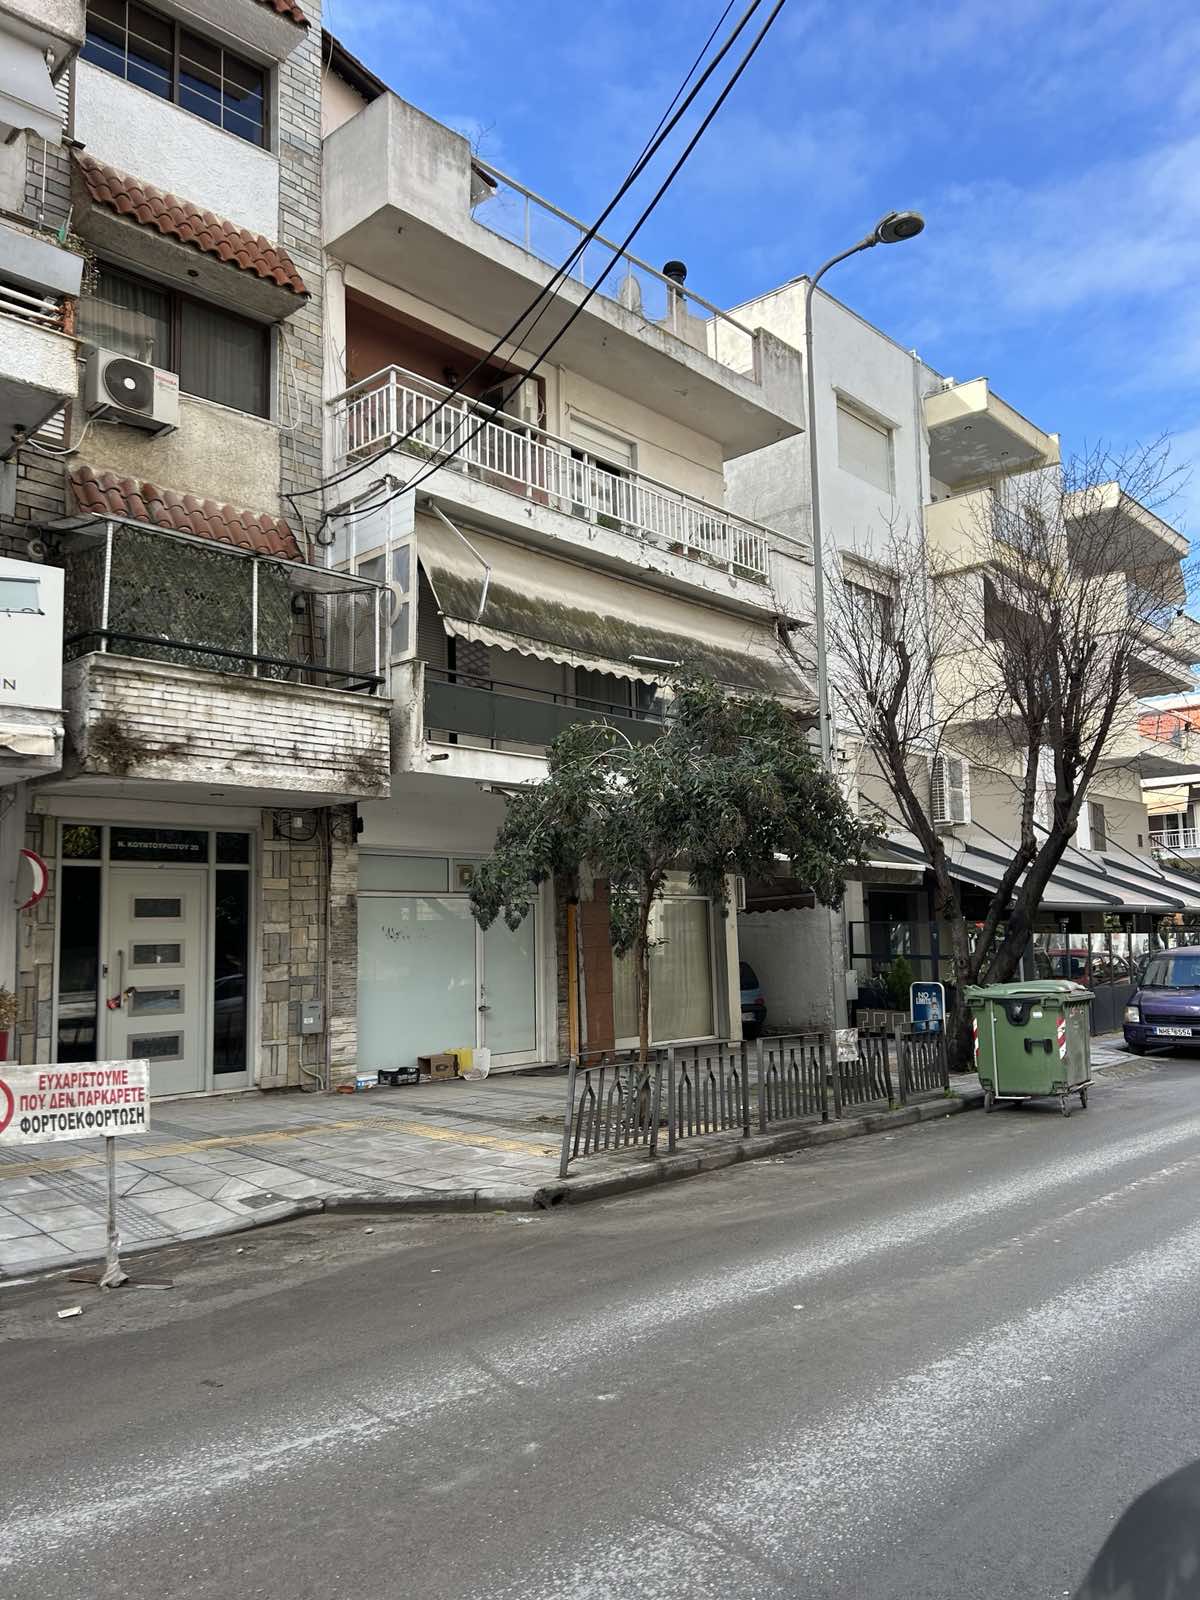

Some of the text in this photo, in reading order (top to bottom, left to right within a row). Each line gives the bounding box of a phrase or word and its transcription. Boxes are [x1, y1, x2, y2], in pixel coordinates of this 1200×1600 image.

[38, 1070, 129, 1091] ΕΥΧΑΡΙΣΤΟΥΜΕ
[20, 1087, 145, 1112] ΠΟΥ ΔΕΝ ΠΑΡΚΑΡΕΤΕ
[20, 1107, 145, 1134] ΦΟΡΤΟΕΚΦΟΡΤΩΣΗ
